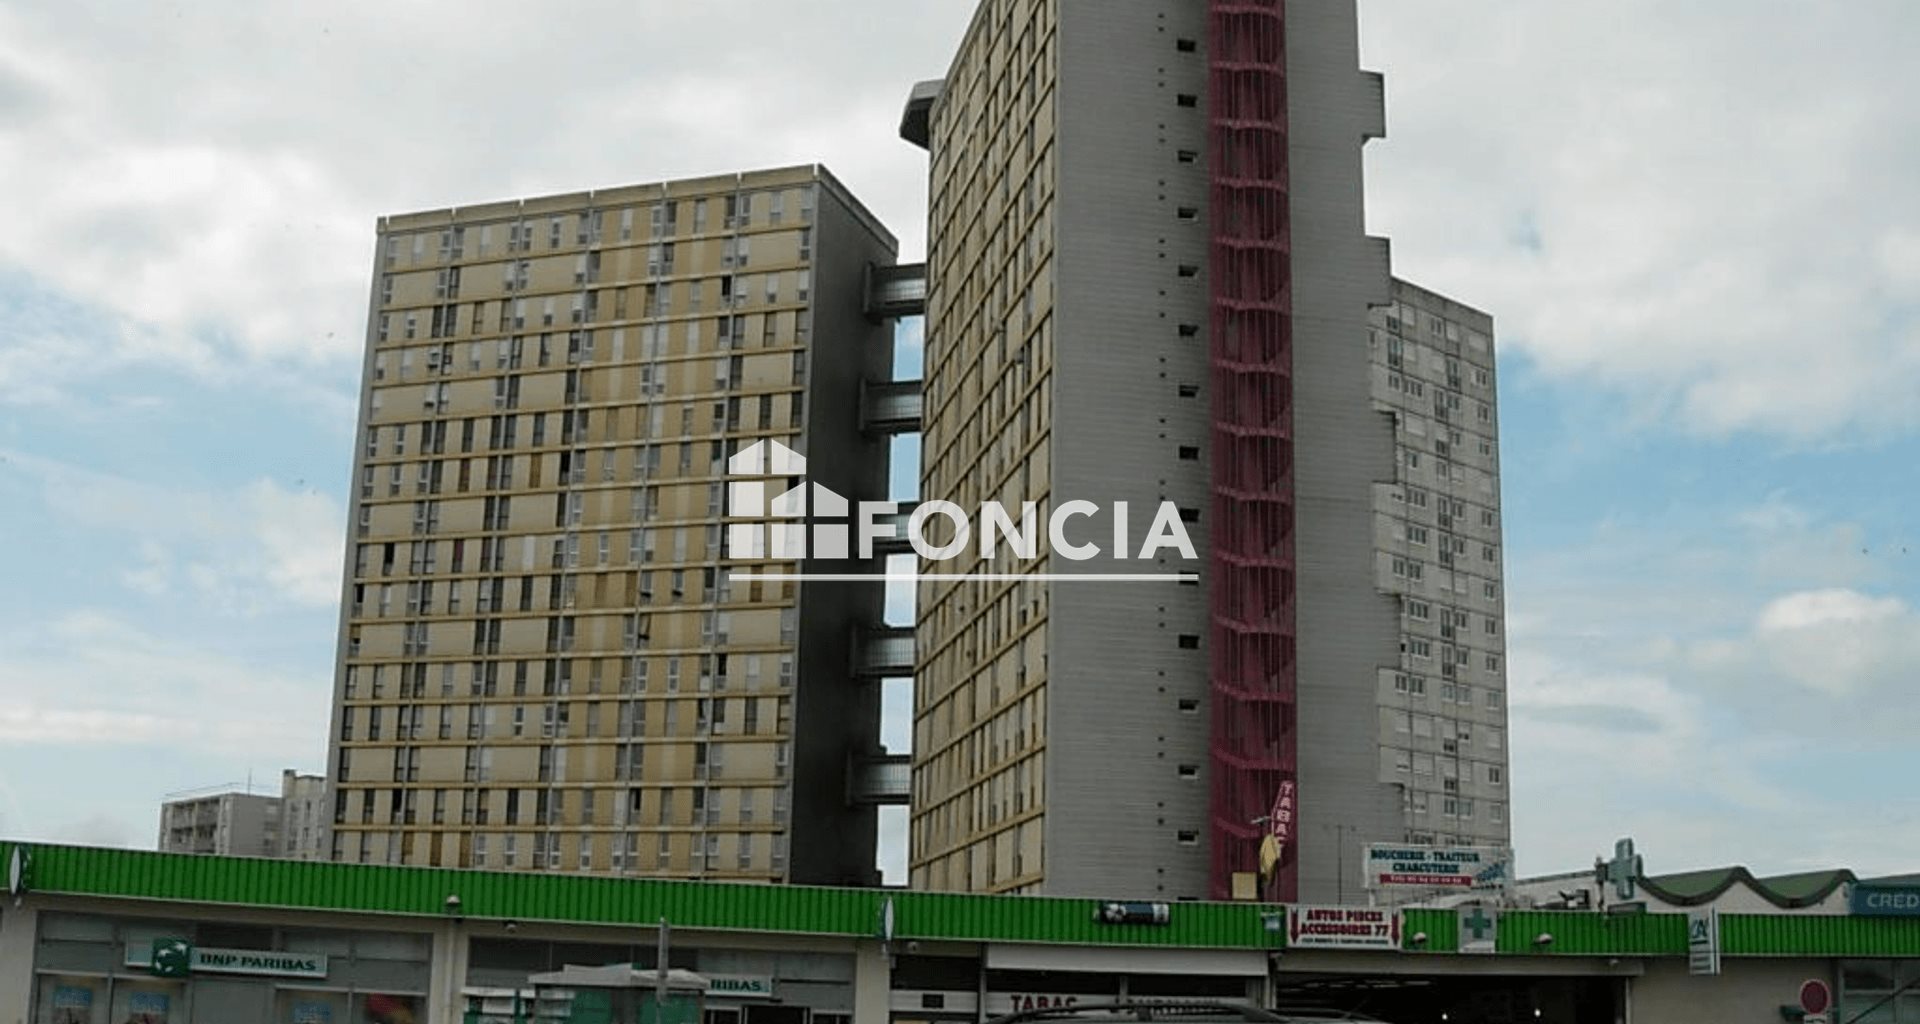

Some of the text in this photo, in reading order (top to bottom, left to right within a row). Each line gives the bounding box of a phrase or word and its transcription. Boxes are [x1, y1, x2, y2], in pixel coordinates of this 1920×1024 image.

[1371, 850, 1425, 861] BOUCHERIE
[1434, 852, 1480, 862] TRAITEUR
[1393, 863, 1460, 873] CHARCUTERIE
[1307, 909, 1343, 921] AUTOS
[1301, 923, 1388, 936] ACCESSOIRES 77
[201, 953, 317, 971] BNP PARIBAS
